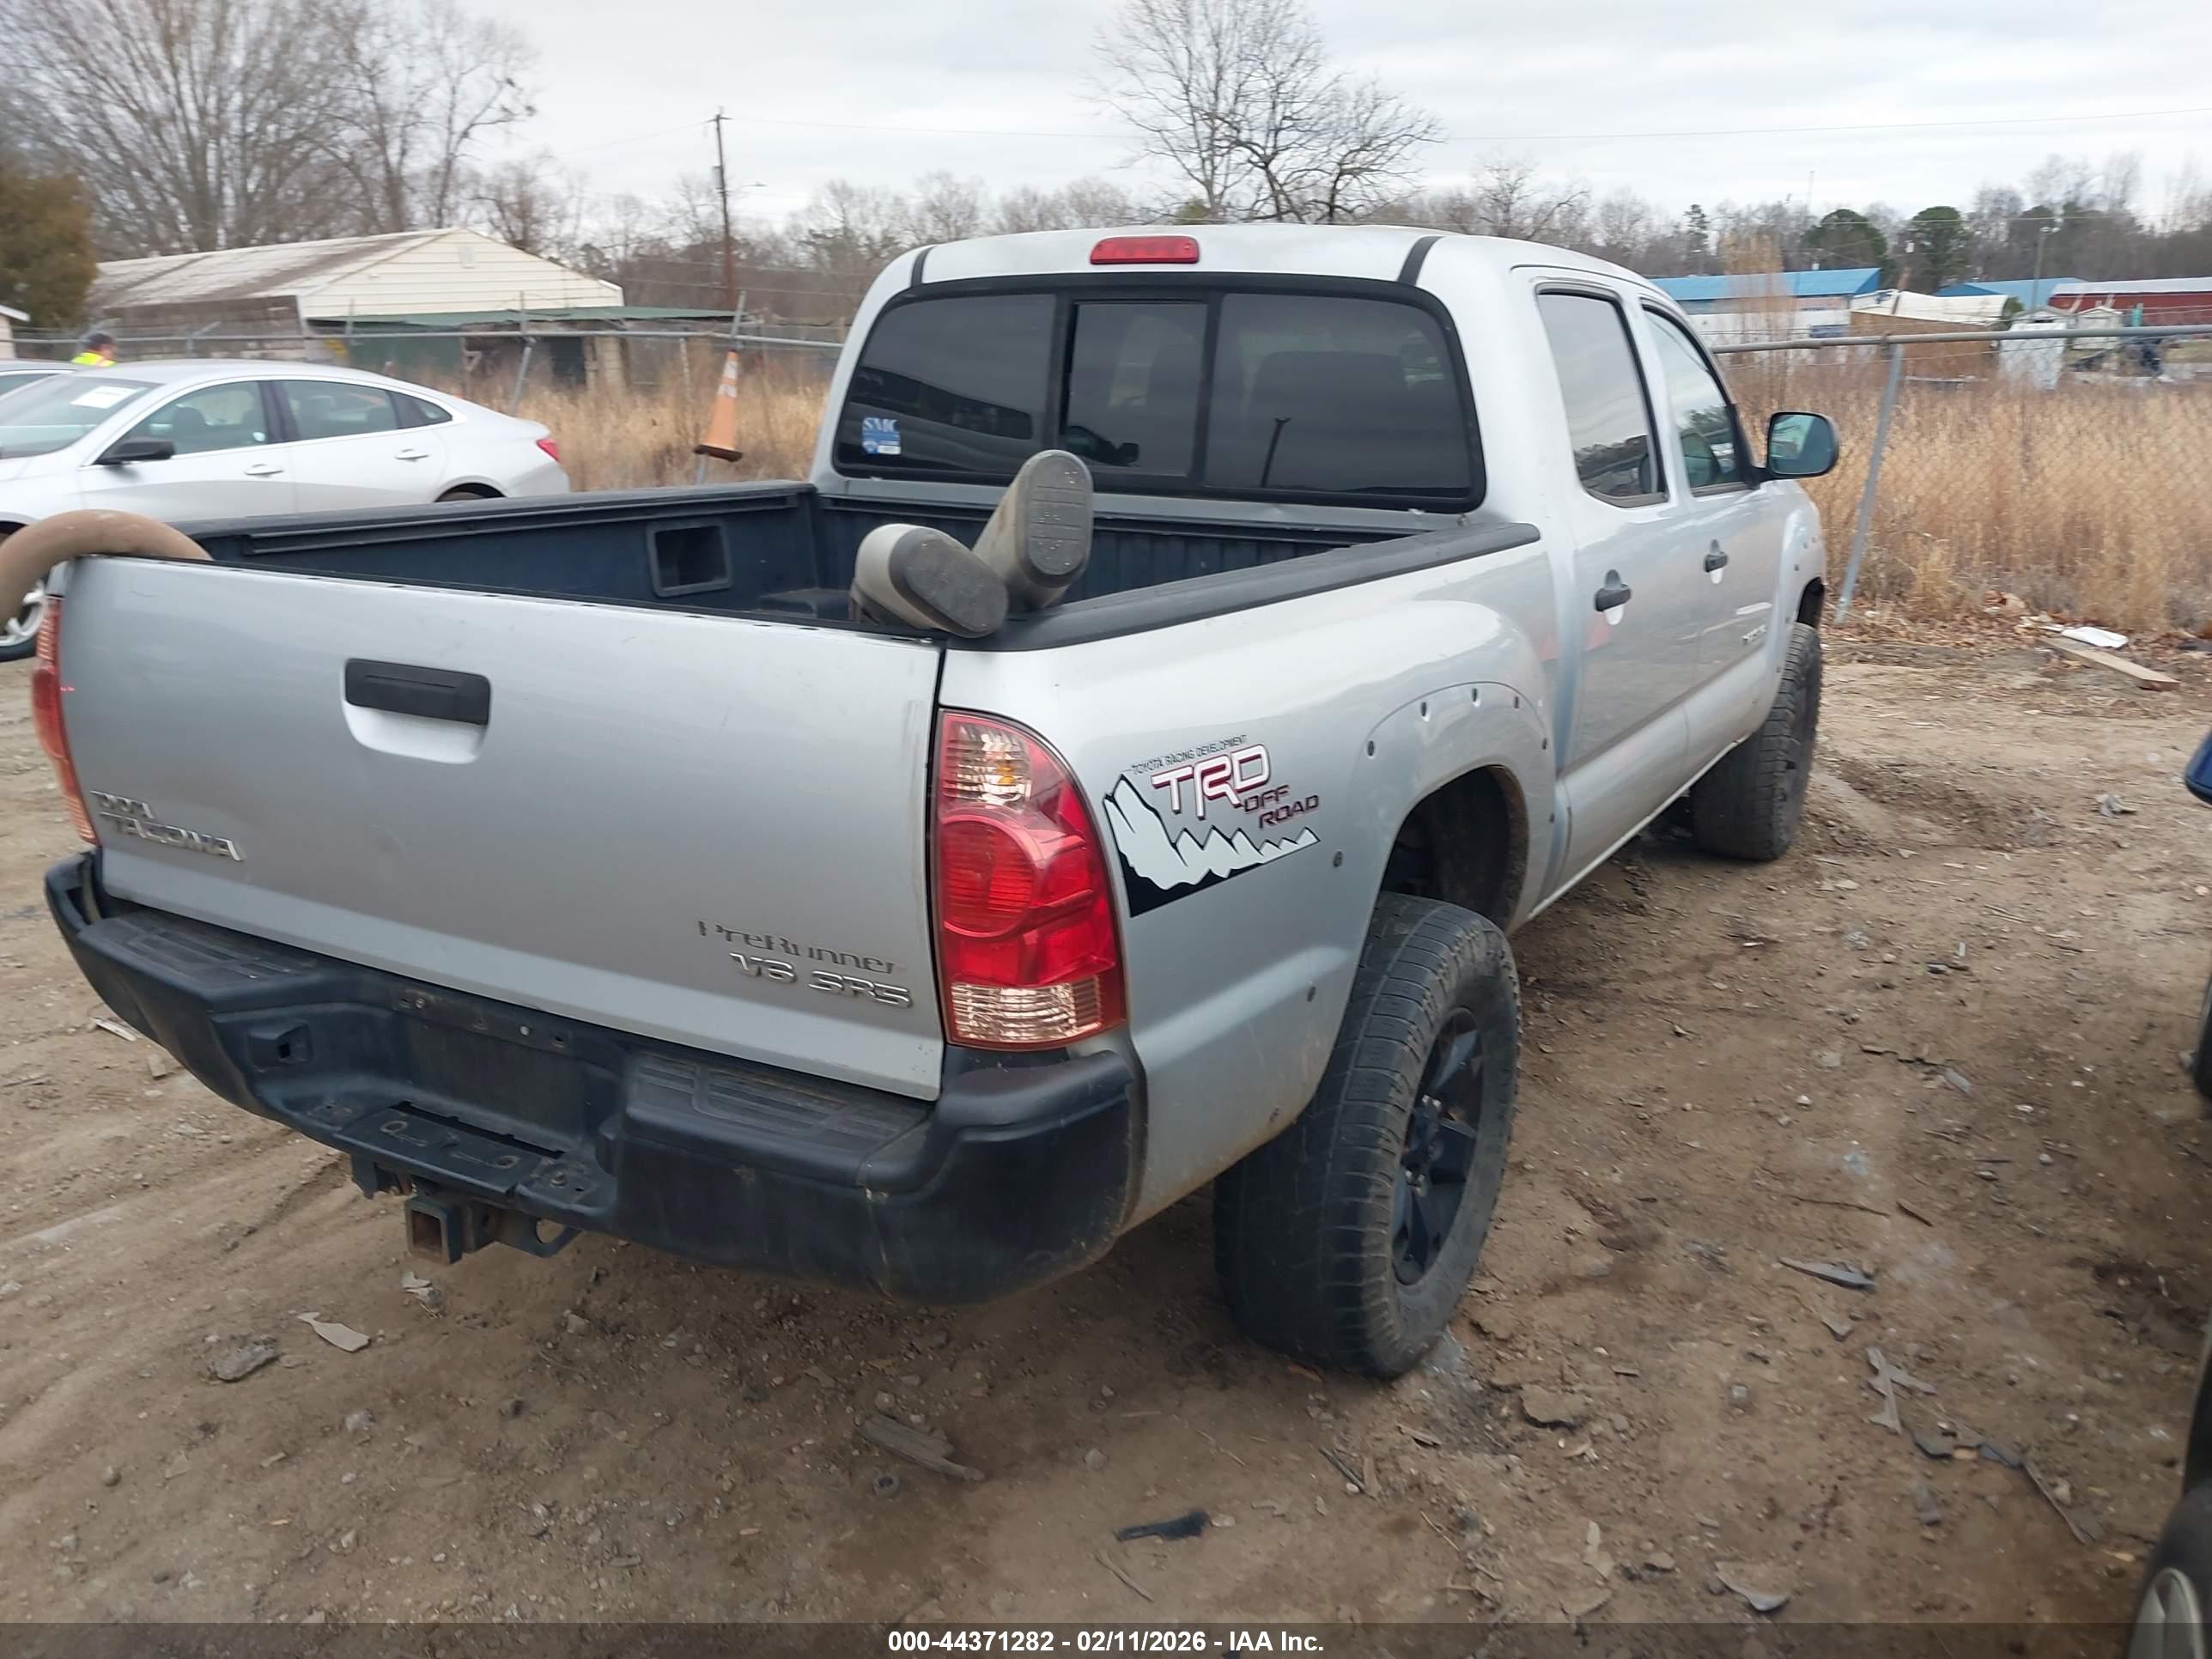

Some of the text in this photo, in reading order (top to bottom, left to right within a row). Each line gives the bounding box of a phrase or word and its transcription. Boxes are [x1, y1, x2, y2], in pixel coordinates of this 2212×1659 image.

[1131, 734, 1247, 775] TOYOTA RACING DEVELOPMENT
[1151, 742, 1272, 820] TRD
[1243, 784, 1290, 812] OFF
[100, 811, 244, 861] TACOMA
[1259, 794, 1320, 828] ROAD
[697, 920, 903, 975] PreRunner
[728, 952, 914, 1008] V6 SR5
